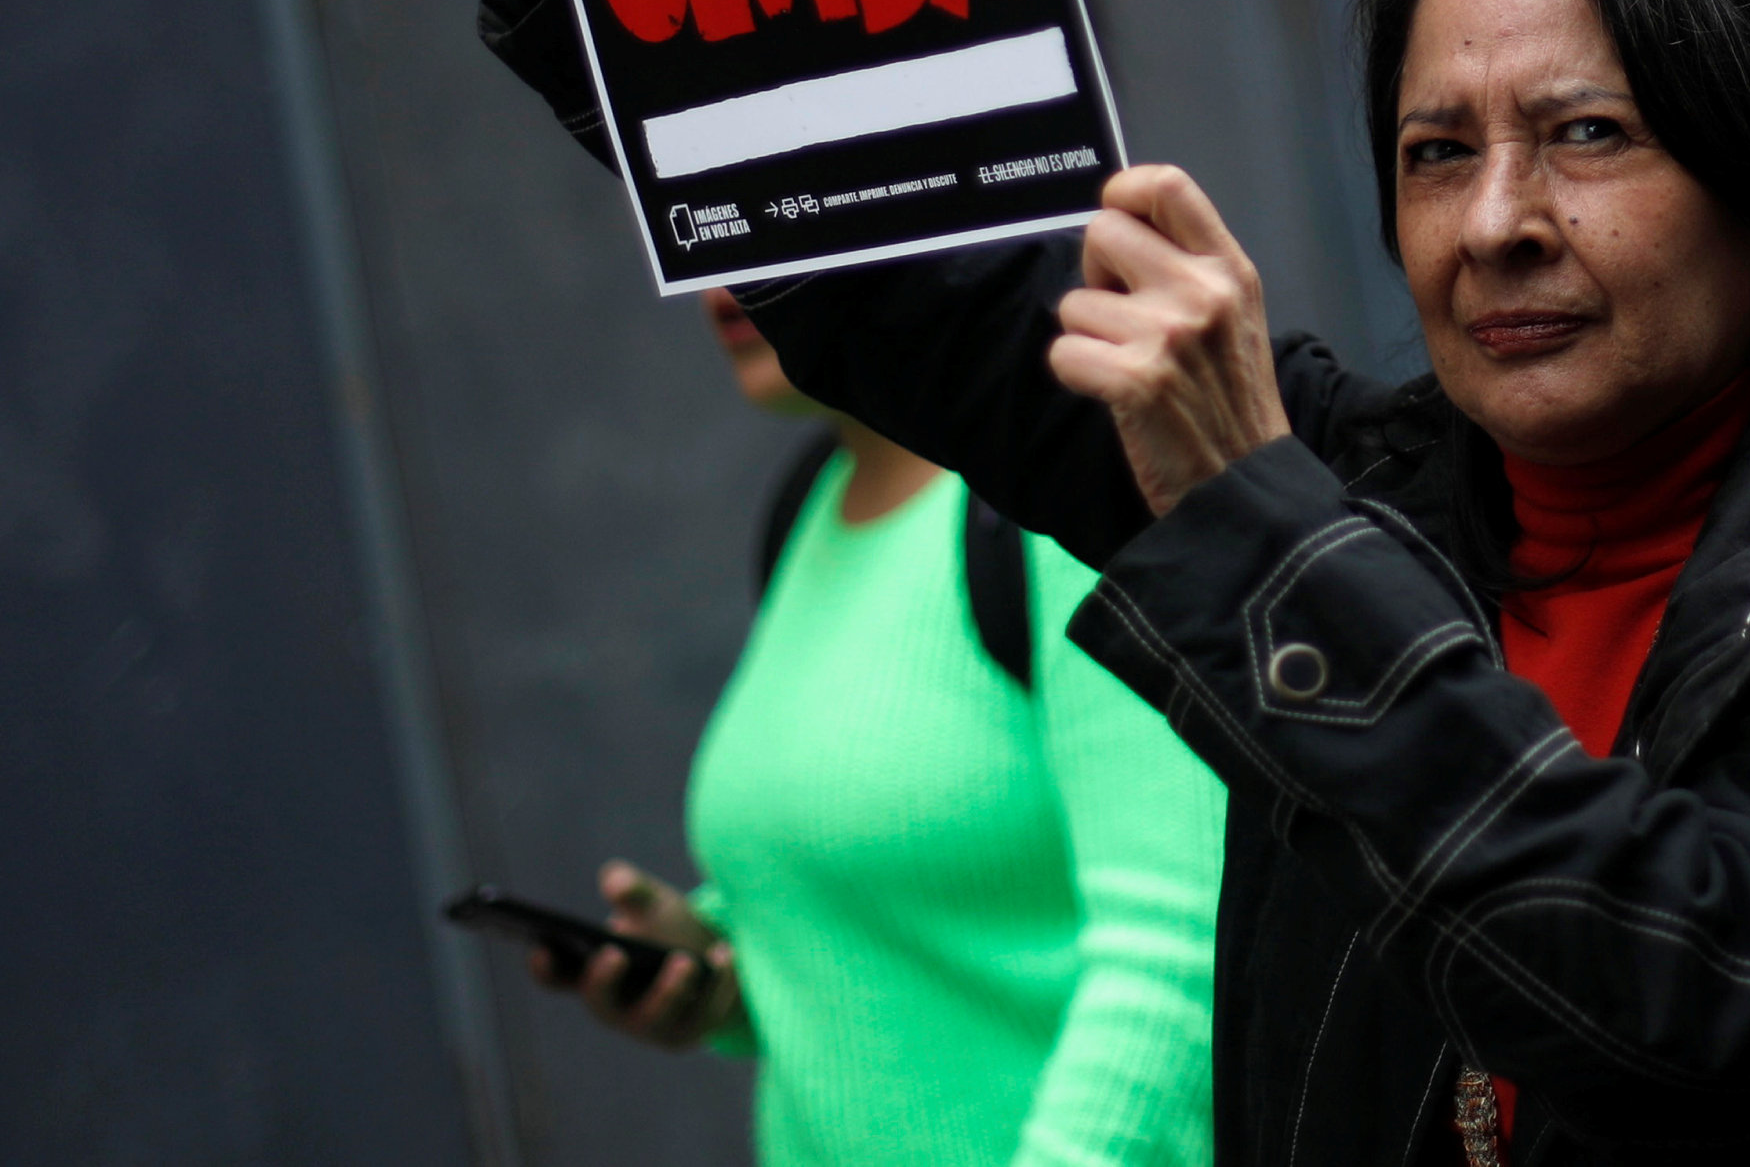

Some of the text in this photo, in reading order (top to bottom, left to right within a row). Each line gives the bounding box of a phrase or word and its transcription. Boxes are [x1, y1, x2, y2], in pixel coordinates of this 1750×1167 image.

[978, 145, 1100, 184] EL SILENCIO NO ES OPCIÓN.
[889, 180, 923, 195] DENUNCIA
[922, 178, 928, 189] Y
[928, 173, 957, 188] DISCUTE
[693, 203, 740, 224] IMÁGENES
[699, 219, 751, 241] EN VOZ ALTA
